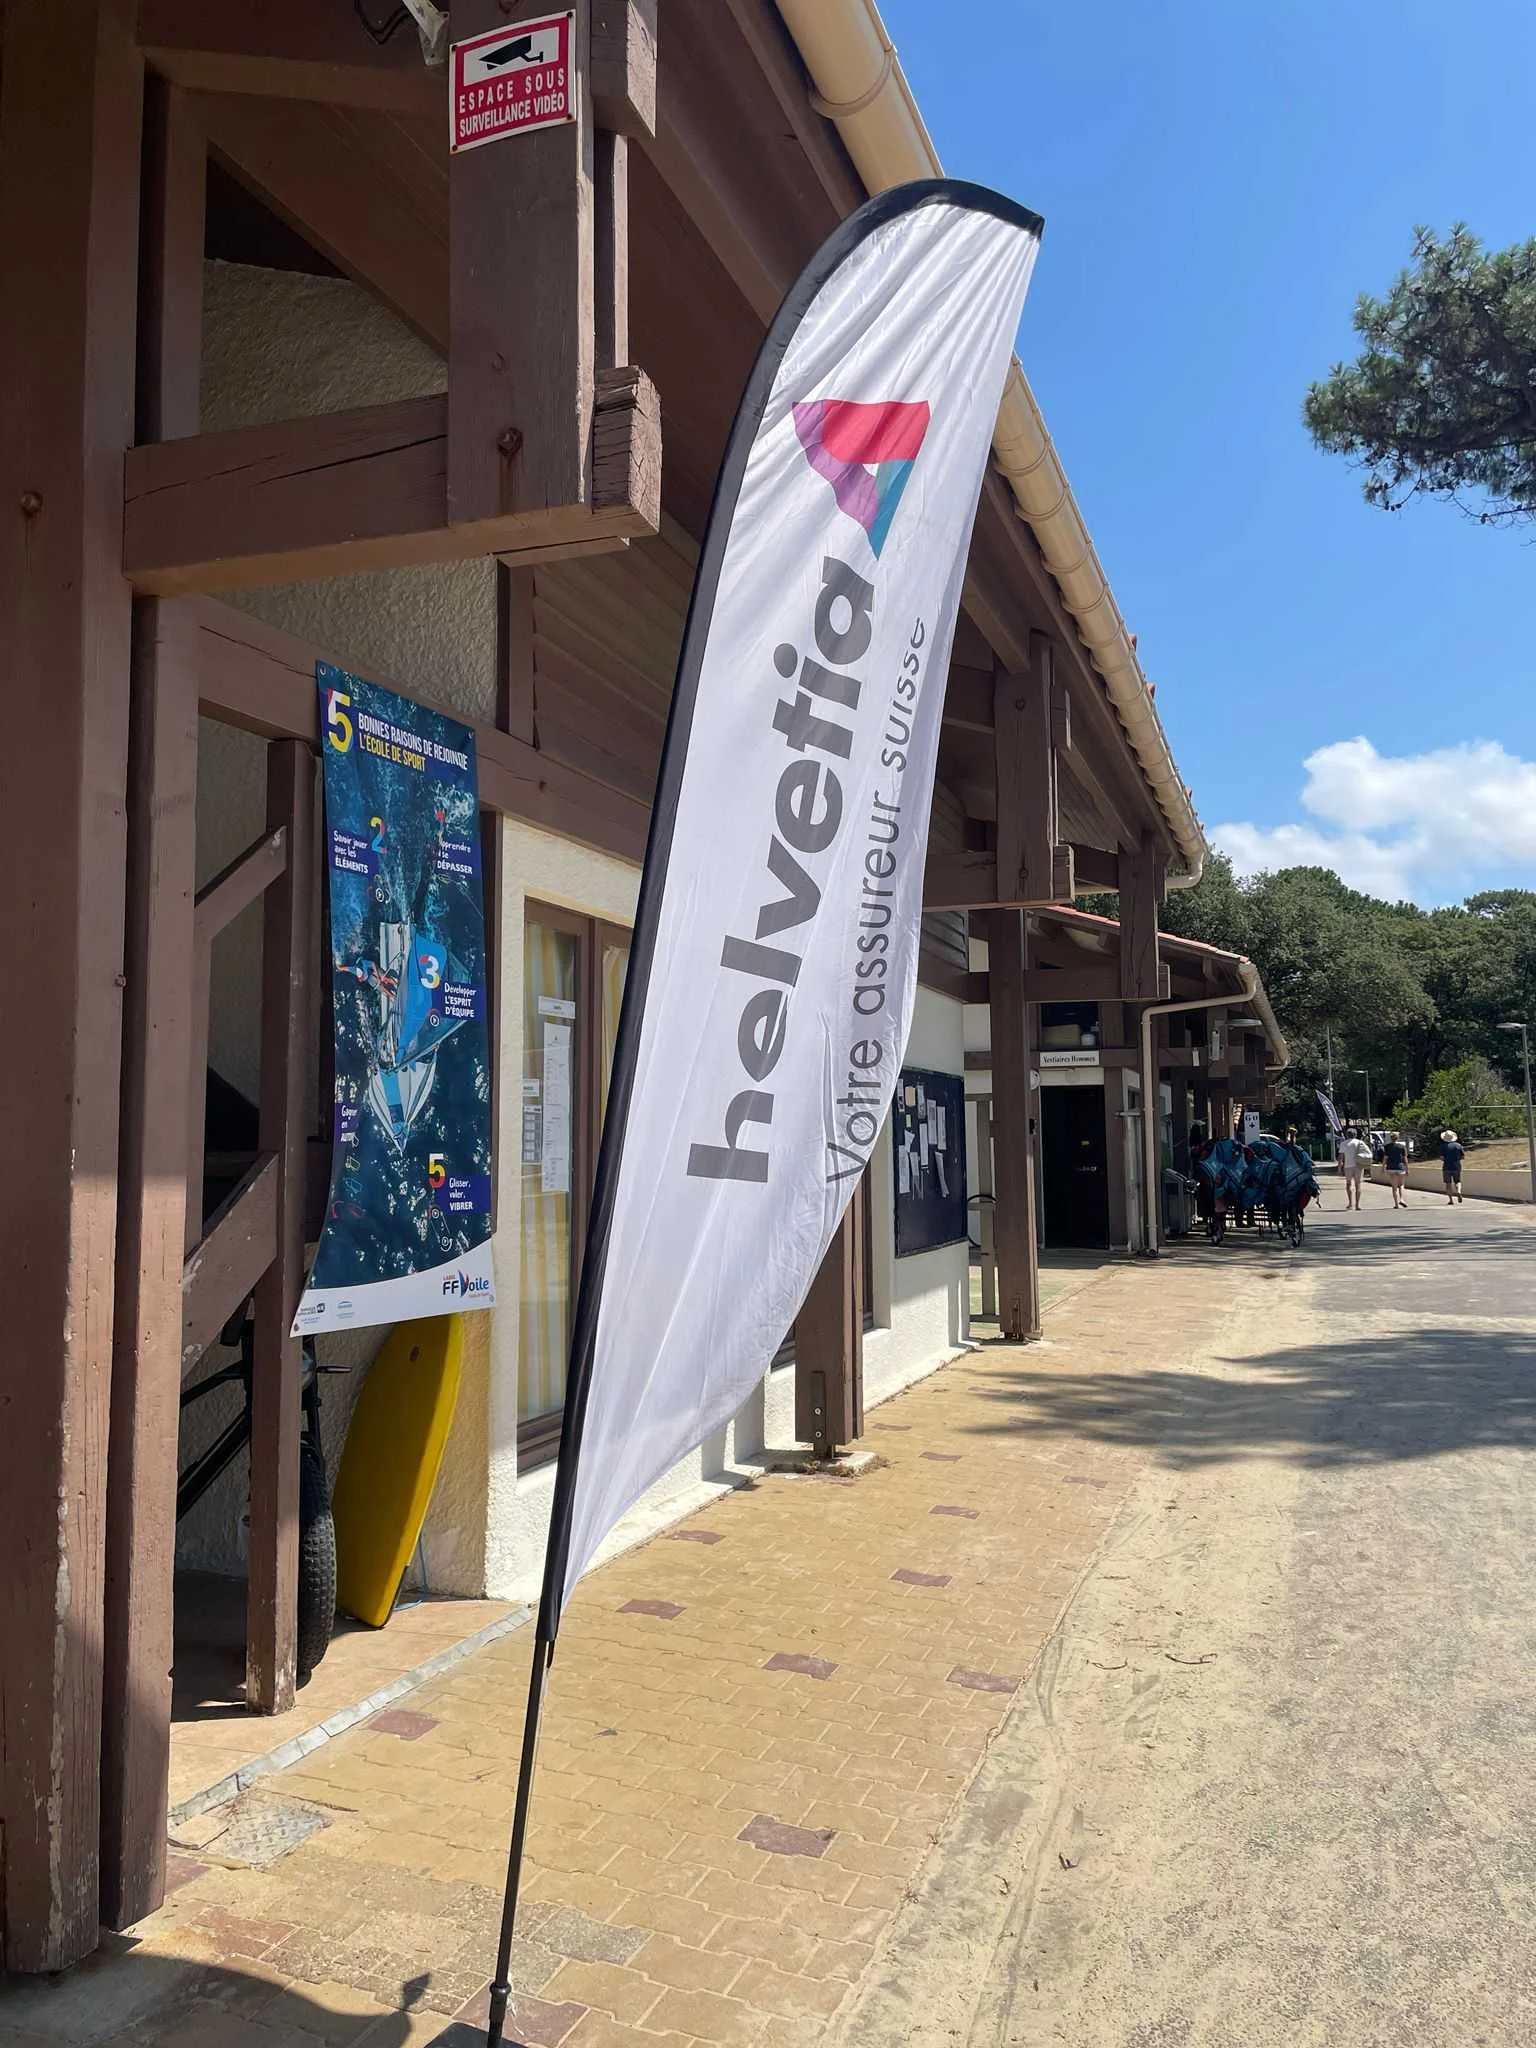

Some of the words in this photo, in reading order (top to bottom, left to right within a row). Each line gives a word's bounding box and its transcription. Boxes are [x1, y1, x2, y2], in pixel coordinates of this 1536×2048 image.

[459, 80, 514, 114] ESPACE
[525, 67, 565, 94] SOUS
[459, 100, 531, 138] SURVEILLANCE
[533, 89, 565, 116] VIDÉO
[881, 617, 926, 773] suisse
[327, 688, 353, 753] 5
[358, 711, 390, 741] BONNES
[390, 723, 422, 753] RAISONS
[423, 738, 433, 757] DE
[359, 732, 391, 759] L'ÉCOLE
[391, 744, 402, 763] DE
[402, 748, 426, 772] SPORT
[370, 816, 387, 855] 2
[439, 840, 472, 853] pprendre
[335, 855, 369, 874] ÉLÉMENTS
[437, 859, 473, 875] DÉPASSER
[686, 555, 875, 1184] helvetia
[852, 789, 901, 1016] assureur
[419, 954, 441, 989] 3
[444, 995, 472, 1007] L'ESPRIT
[445, 1004, 475, 1018] D'ÉQUIPE
[826, 1039, 884, 1184] Votre
[428, 1153, 446, 1189] 5
[449, 1201, 473, 1211] VIBRER
